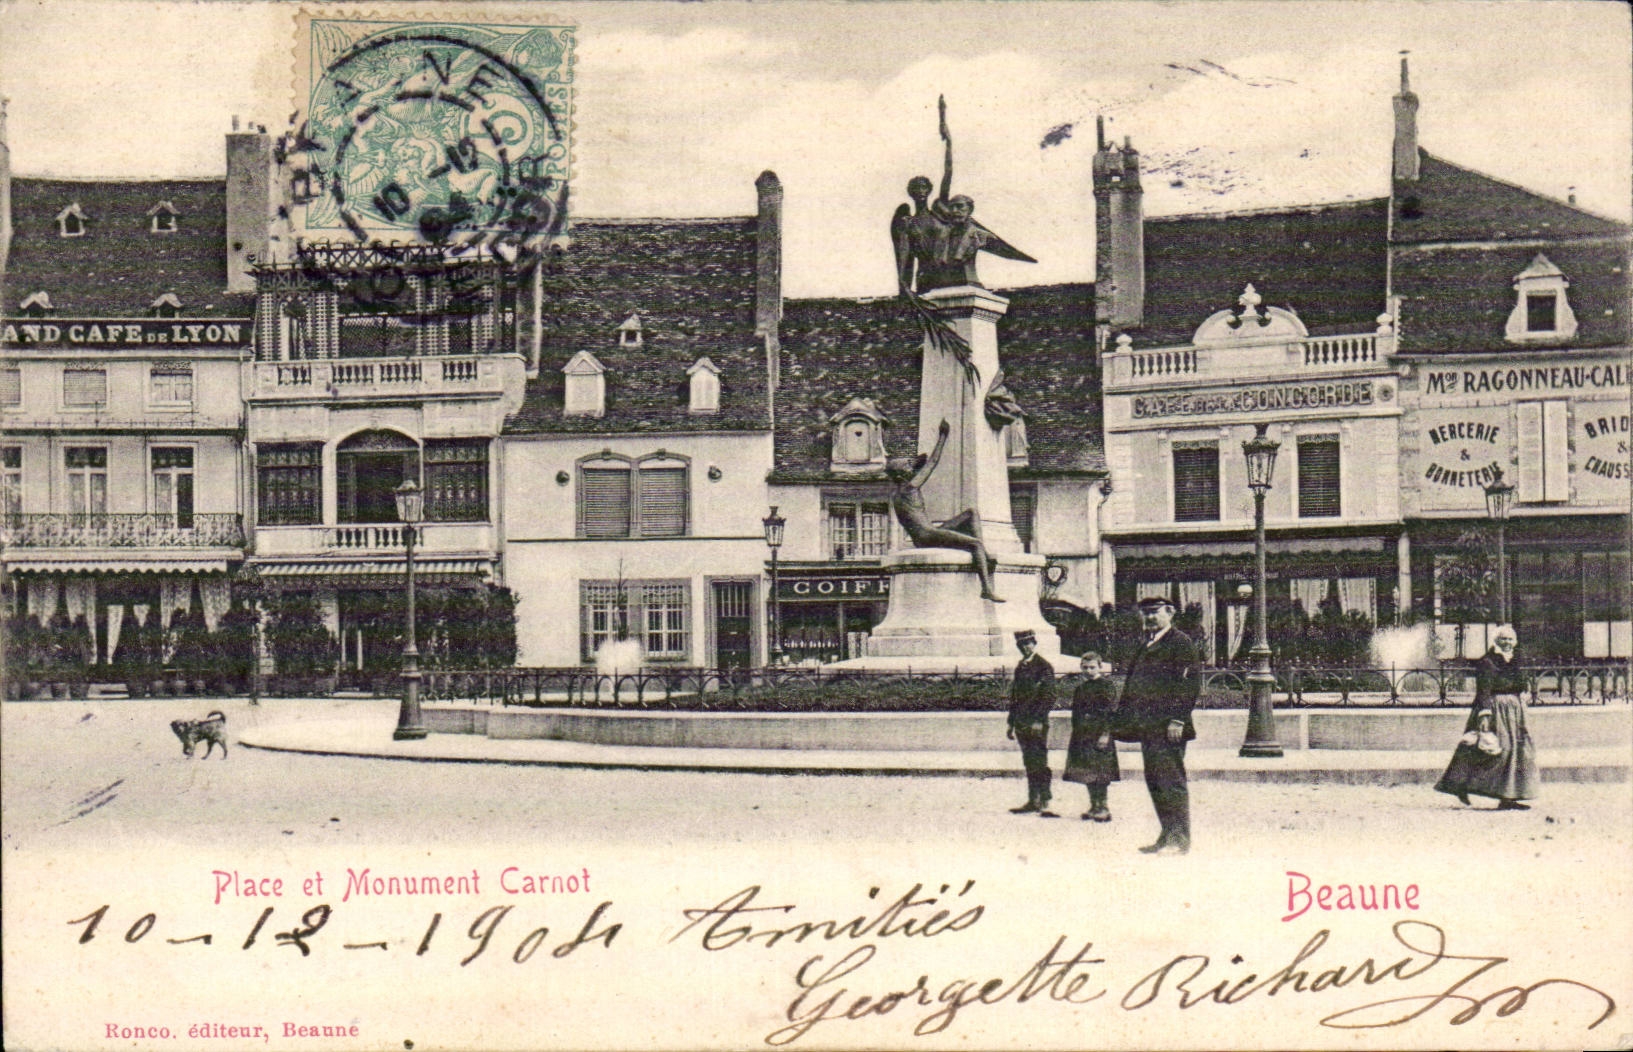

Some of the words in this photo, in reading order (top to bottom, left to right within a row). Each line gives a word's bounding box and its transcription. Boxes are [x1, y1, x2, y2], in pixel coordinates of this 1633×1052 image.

[69, 324, 142, 343] CAFE
[147, 333, 168, 343] DE
[171, 324, 242, 343] LYON
[1241, 380, 1375, 412] CONCORDE
[1428, 421, 1500, 445] MERCERIE
[1460, 448, 1471, 461] &
[764, 935, 1108, 1046] Georgette
